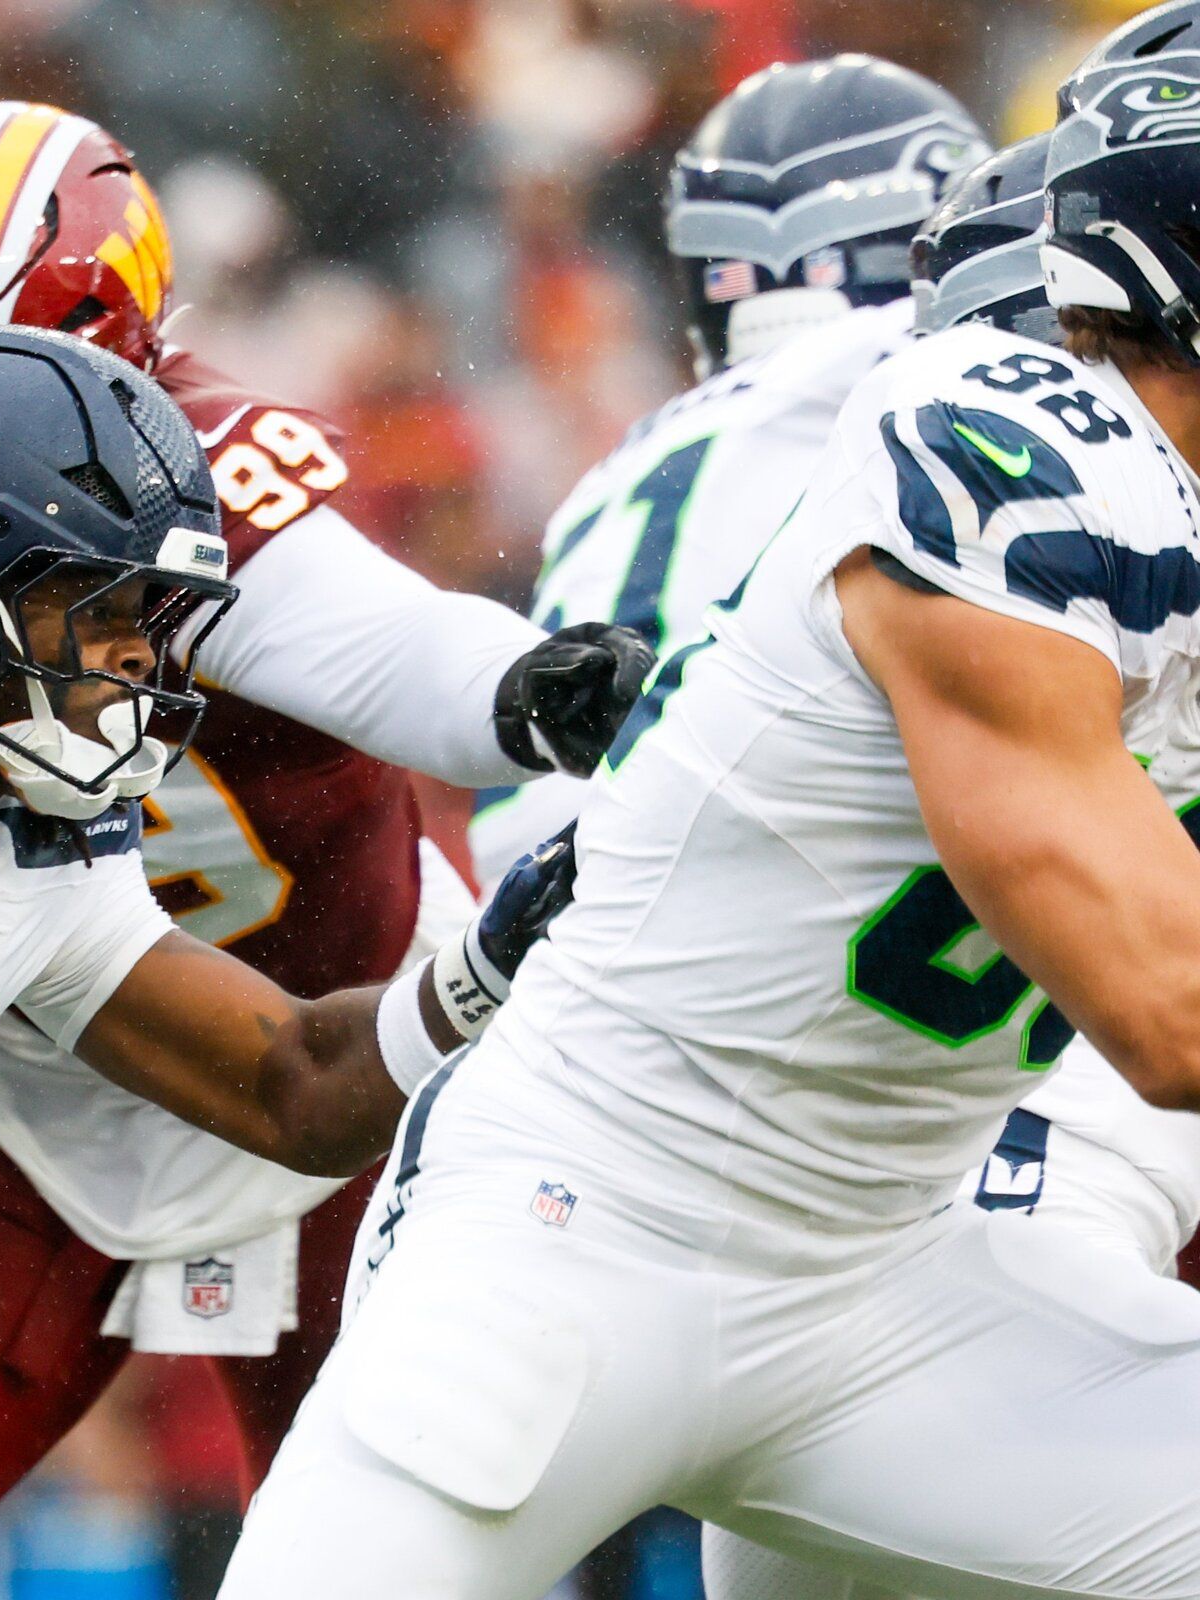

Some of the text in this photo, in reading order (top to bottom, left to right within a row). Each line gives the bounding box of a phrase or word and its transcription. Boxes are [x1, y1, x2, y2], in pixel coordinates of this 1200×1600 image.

[961, 353, 1132, 444] 88
[209, 409, 348, 532] 99
[535, 1194, 568, 1224] NFL
[190, 1286, 226, 1312] NFL
